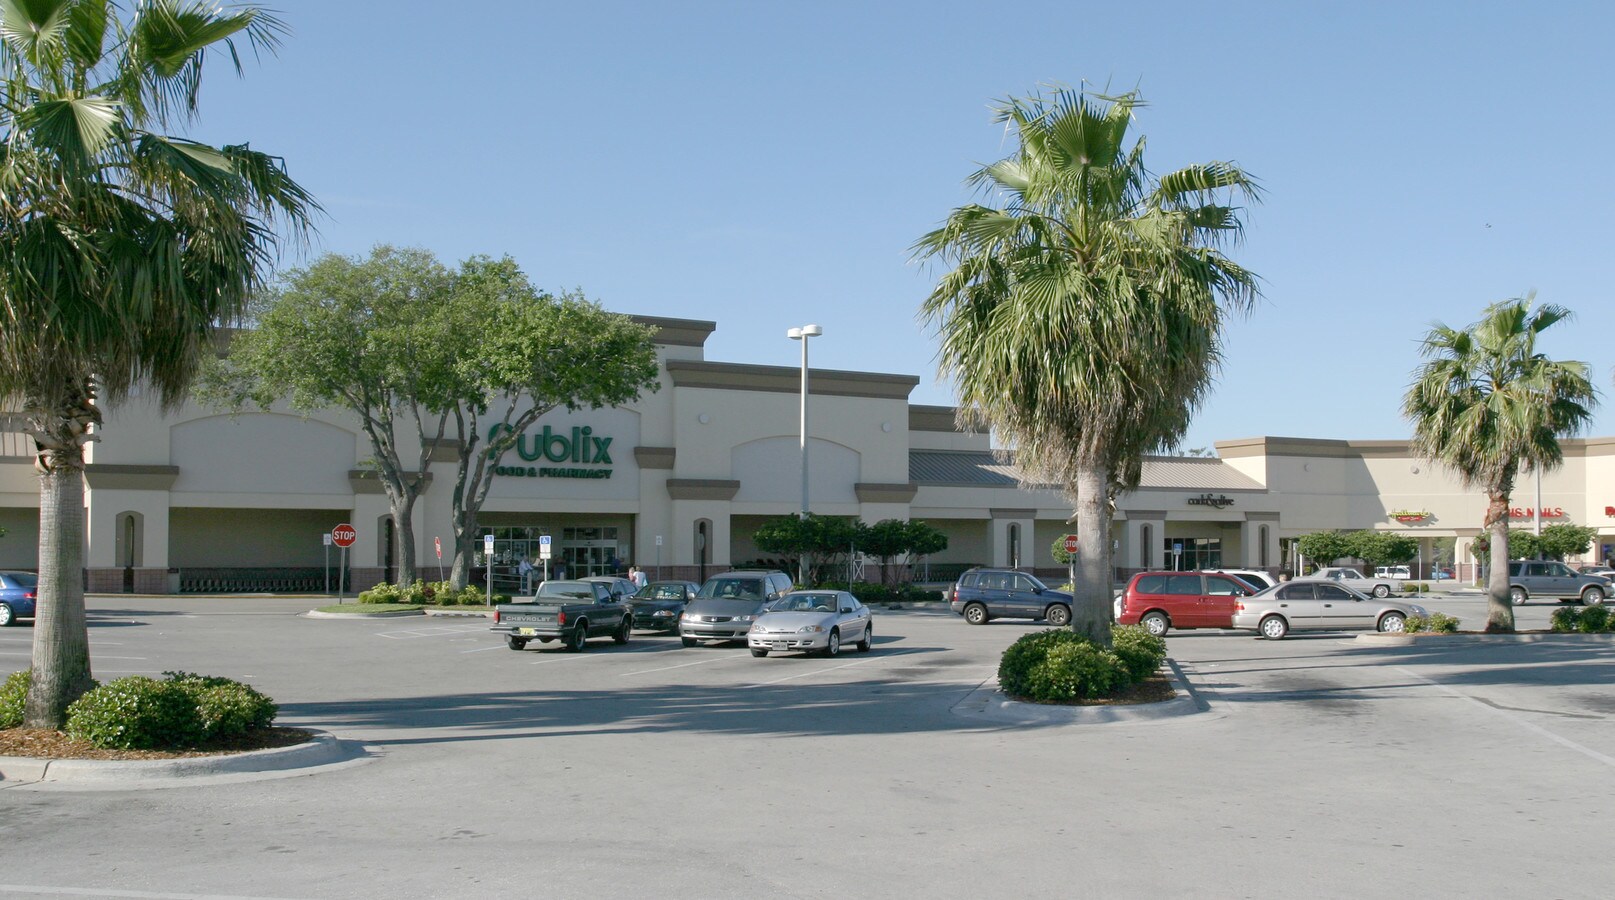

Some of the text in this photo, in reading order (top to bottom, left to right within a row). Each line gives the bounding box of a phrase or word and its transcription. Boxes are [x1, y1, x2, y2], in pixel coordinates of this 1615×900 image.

[489, 466, 613, 479] OOD & PHARMACY
[333, 530, 355, 541] STOP
